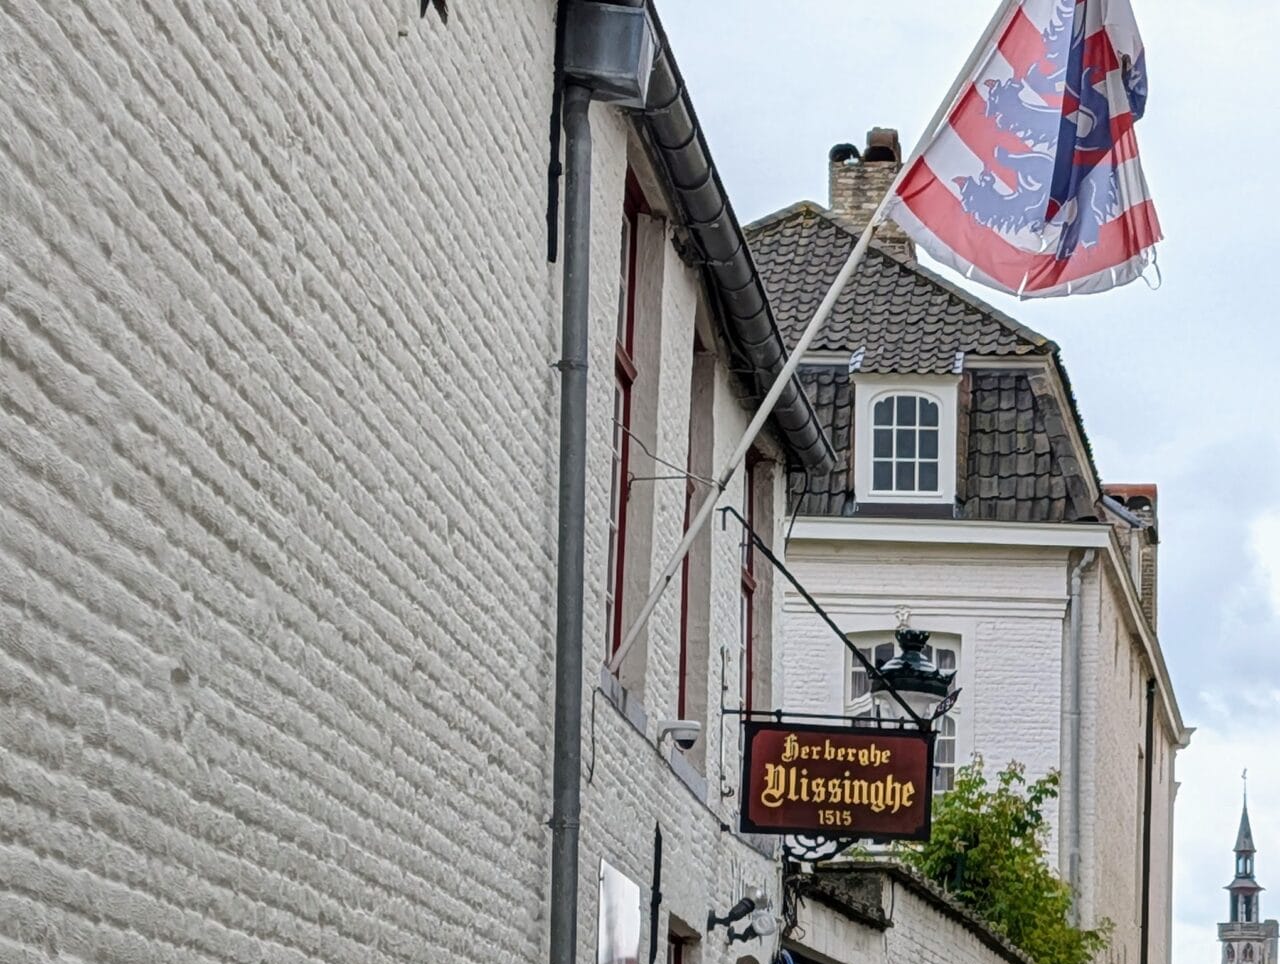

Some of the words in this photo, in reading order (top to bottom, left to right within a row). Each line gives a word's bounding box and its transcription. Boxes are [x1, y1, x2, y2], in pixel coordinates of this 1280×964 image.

[782, 734, 891, 766] Herberghe
[762, 763, 915, 813] Vlissinghe
[819, 810, 852, 826] 1515
